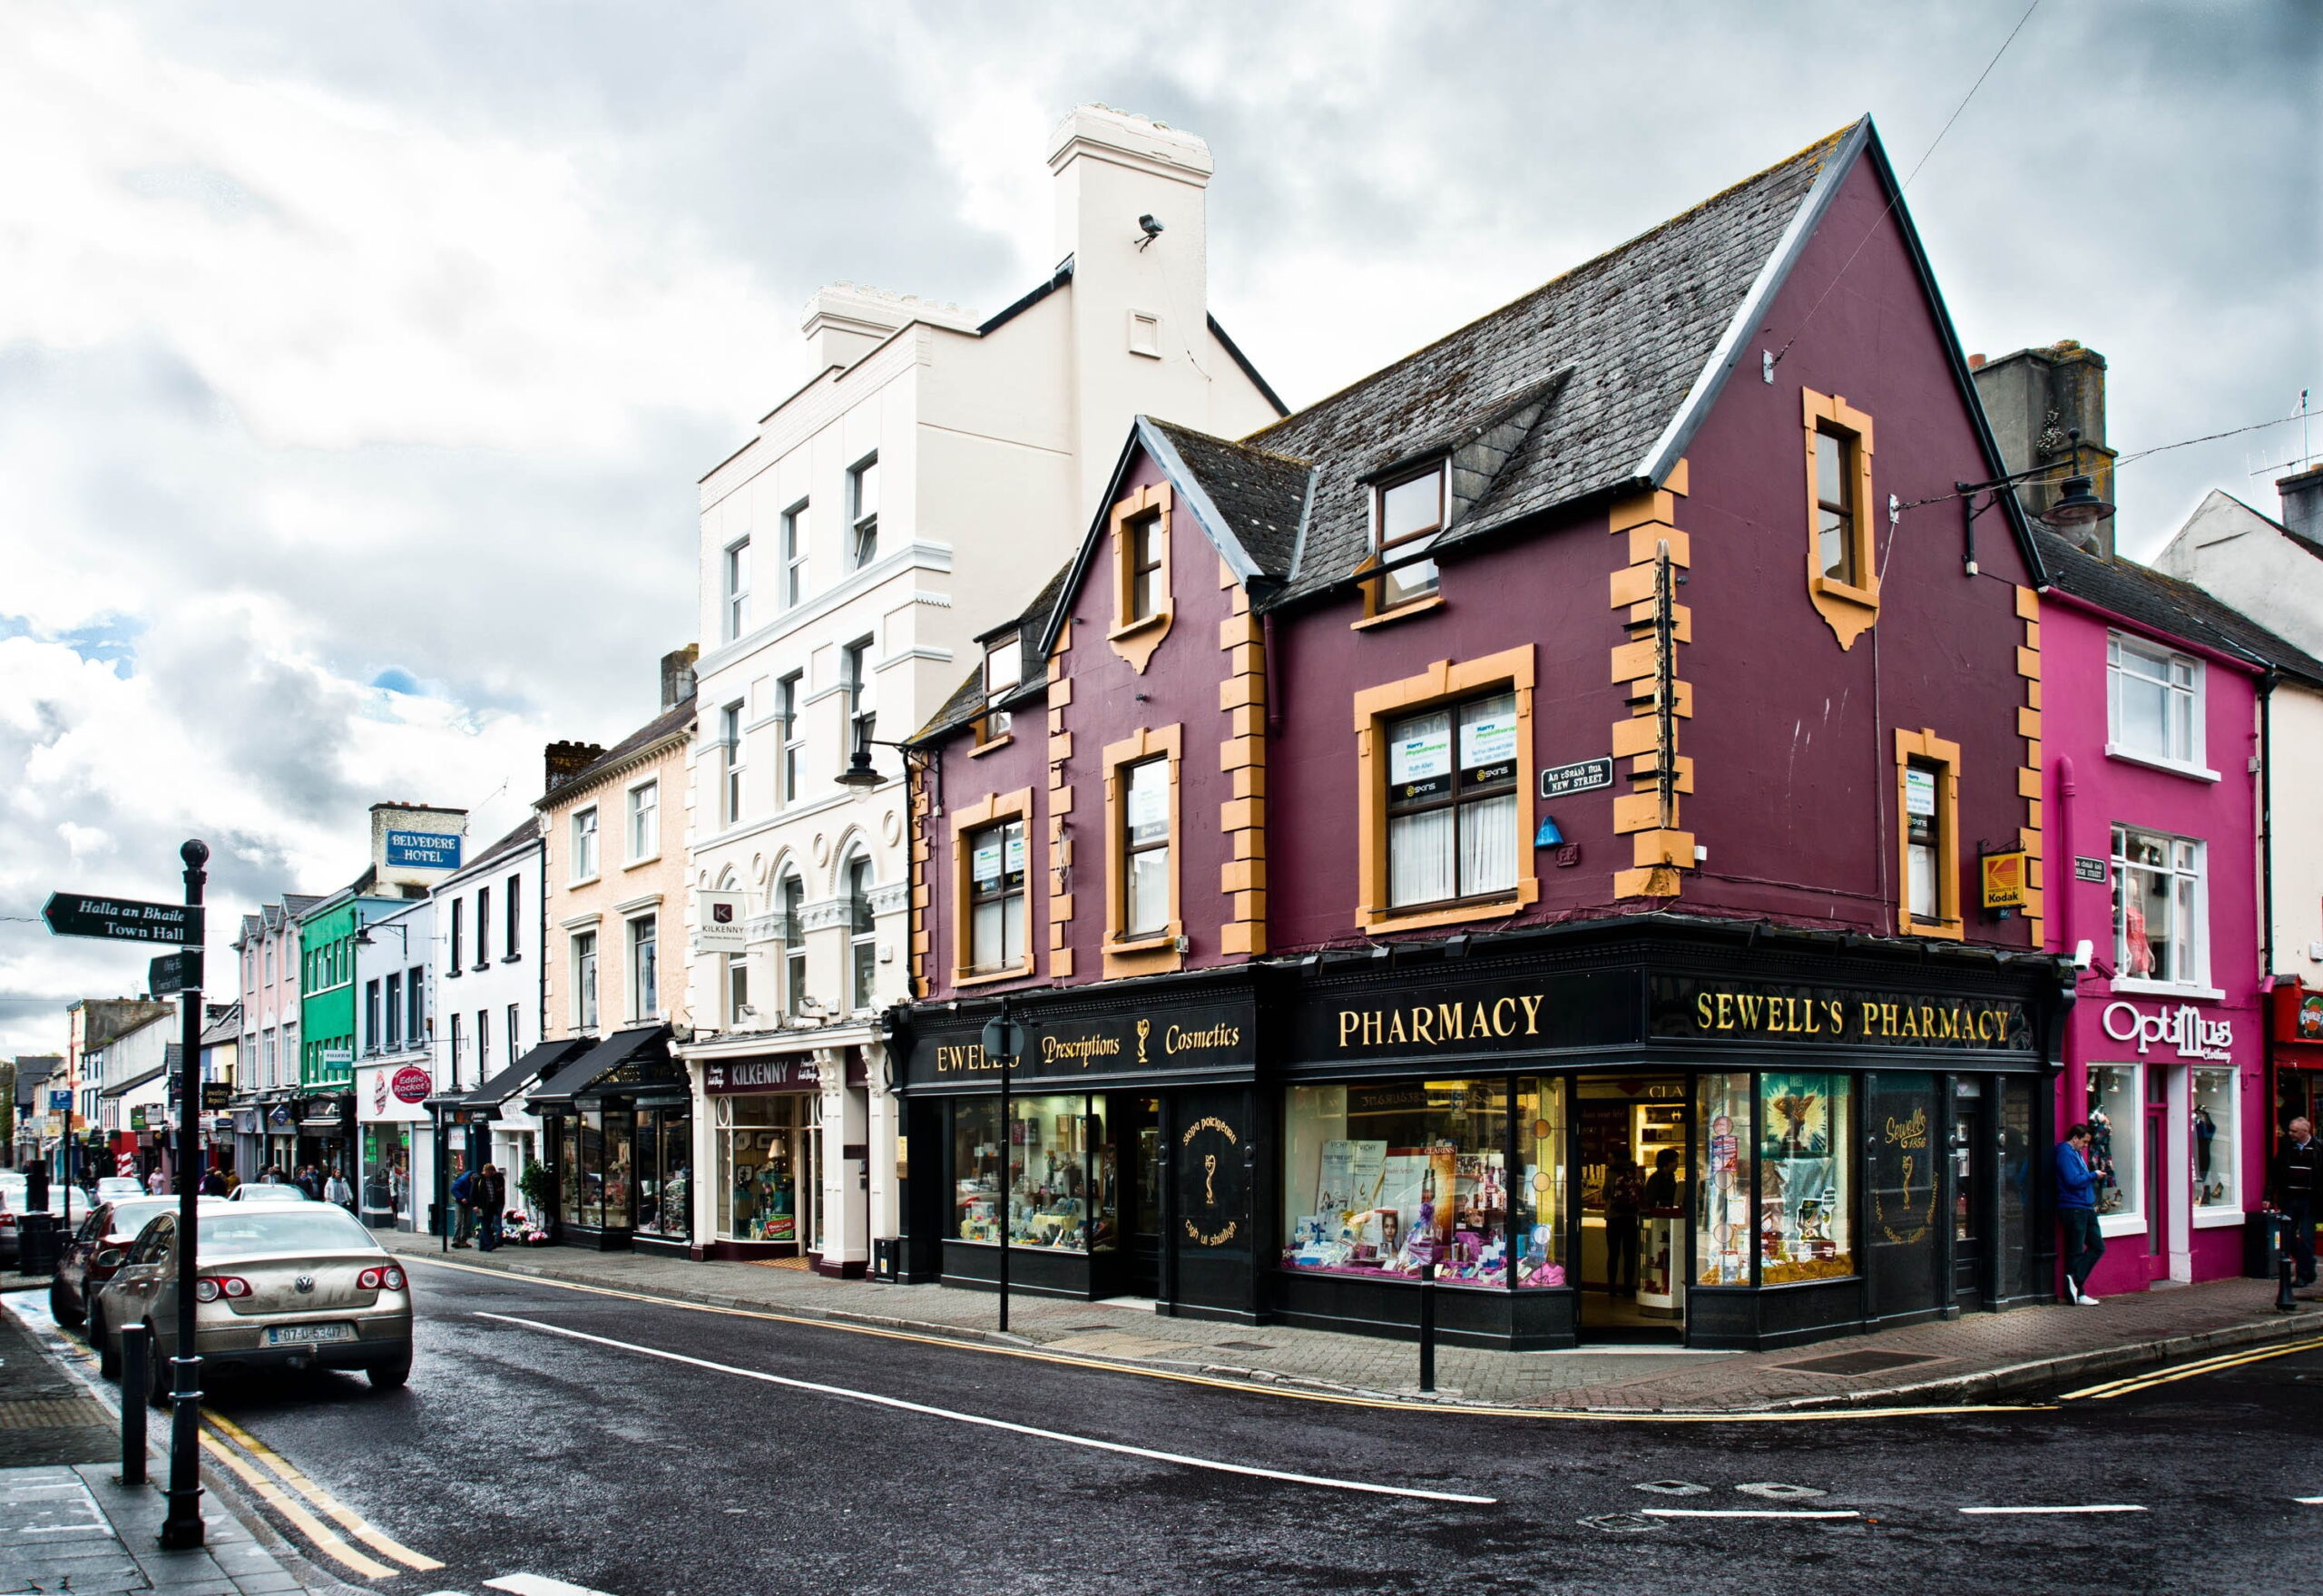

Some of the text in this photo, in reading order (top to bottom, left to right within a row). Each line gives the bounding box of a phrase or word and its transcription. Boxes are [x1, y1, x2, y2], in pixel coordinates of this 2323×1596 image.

[1475, 726, 1517, 739] Physiotherap
[1477, 723, 1495, 732] Kerry
[1407, 741, 1423, 749] Kerry
[1552, 773, 1603, 792] NEW STREET
[392, 835, 456, 849] BELVEDERE
[405, 849, 443, 863] HOTEL
[1988, 892, 2019, 903] Kodak
[79, 900, 185, 923] Halla an Bhaile
[104, 921, 184, 941] Town Hall
[702, 925, 744, 934] KILKENNY
[1339, 994, 1544, 1048] PHARMACY
[1863, 1002, 2009, 1043] PHARMACY
[937, 1023, 1240, 1072] EWEL Prescriptions Cosmetics
[2202, 1047, 2231, 1063] Clothing
[399, 1075, 424, 1084] Eddie
[731, 1061, 789, 1086] KILKENNY
[394, 1081, 431, 1092] Rocket's
[56, 1092, 66, 1101] P
[1425, 1147, 1456, 1155] CLARINS
